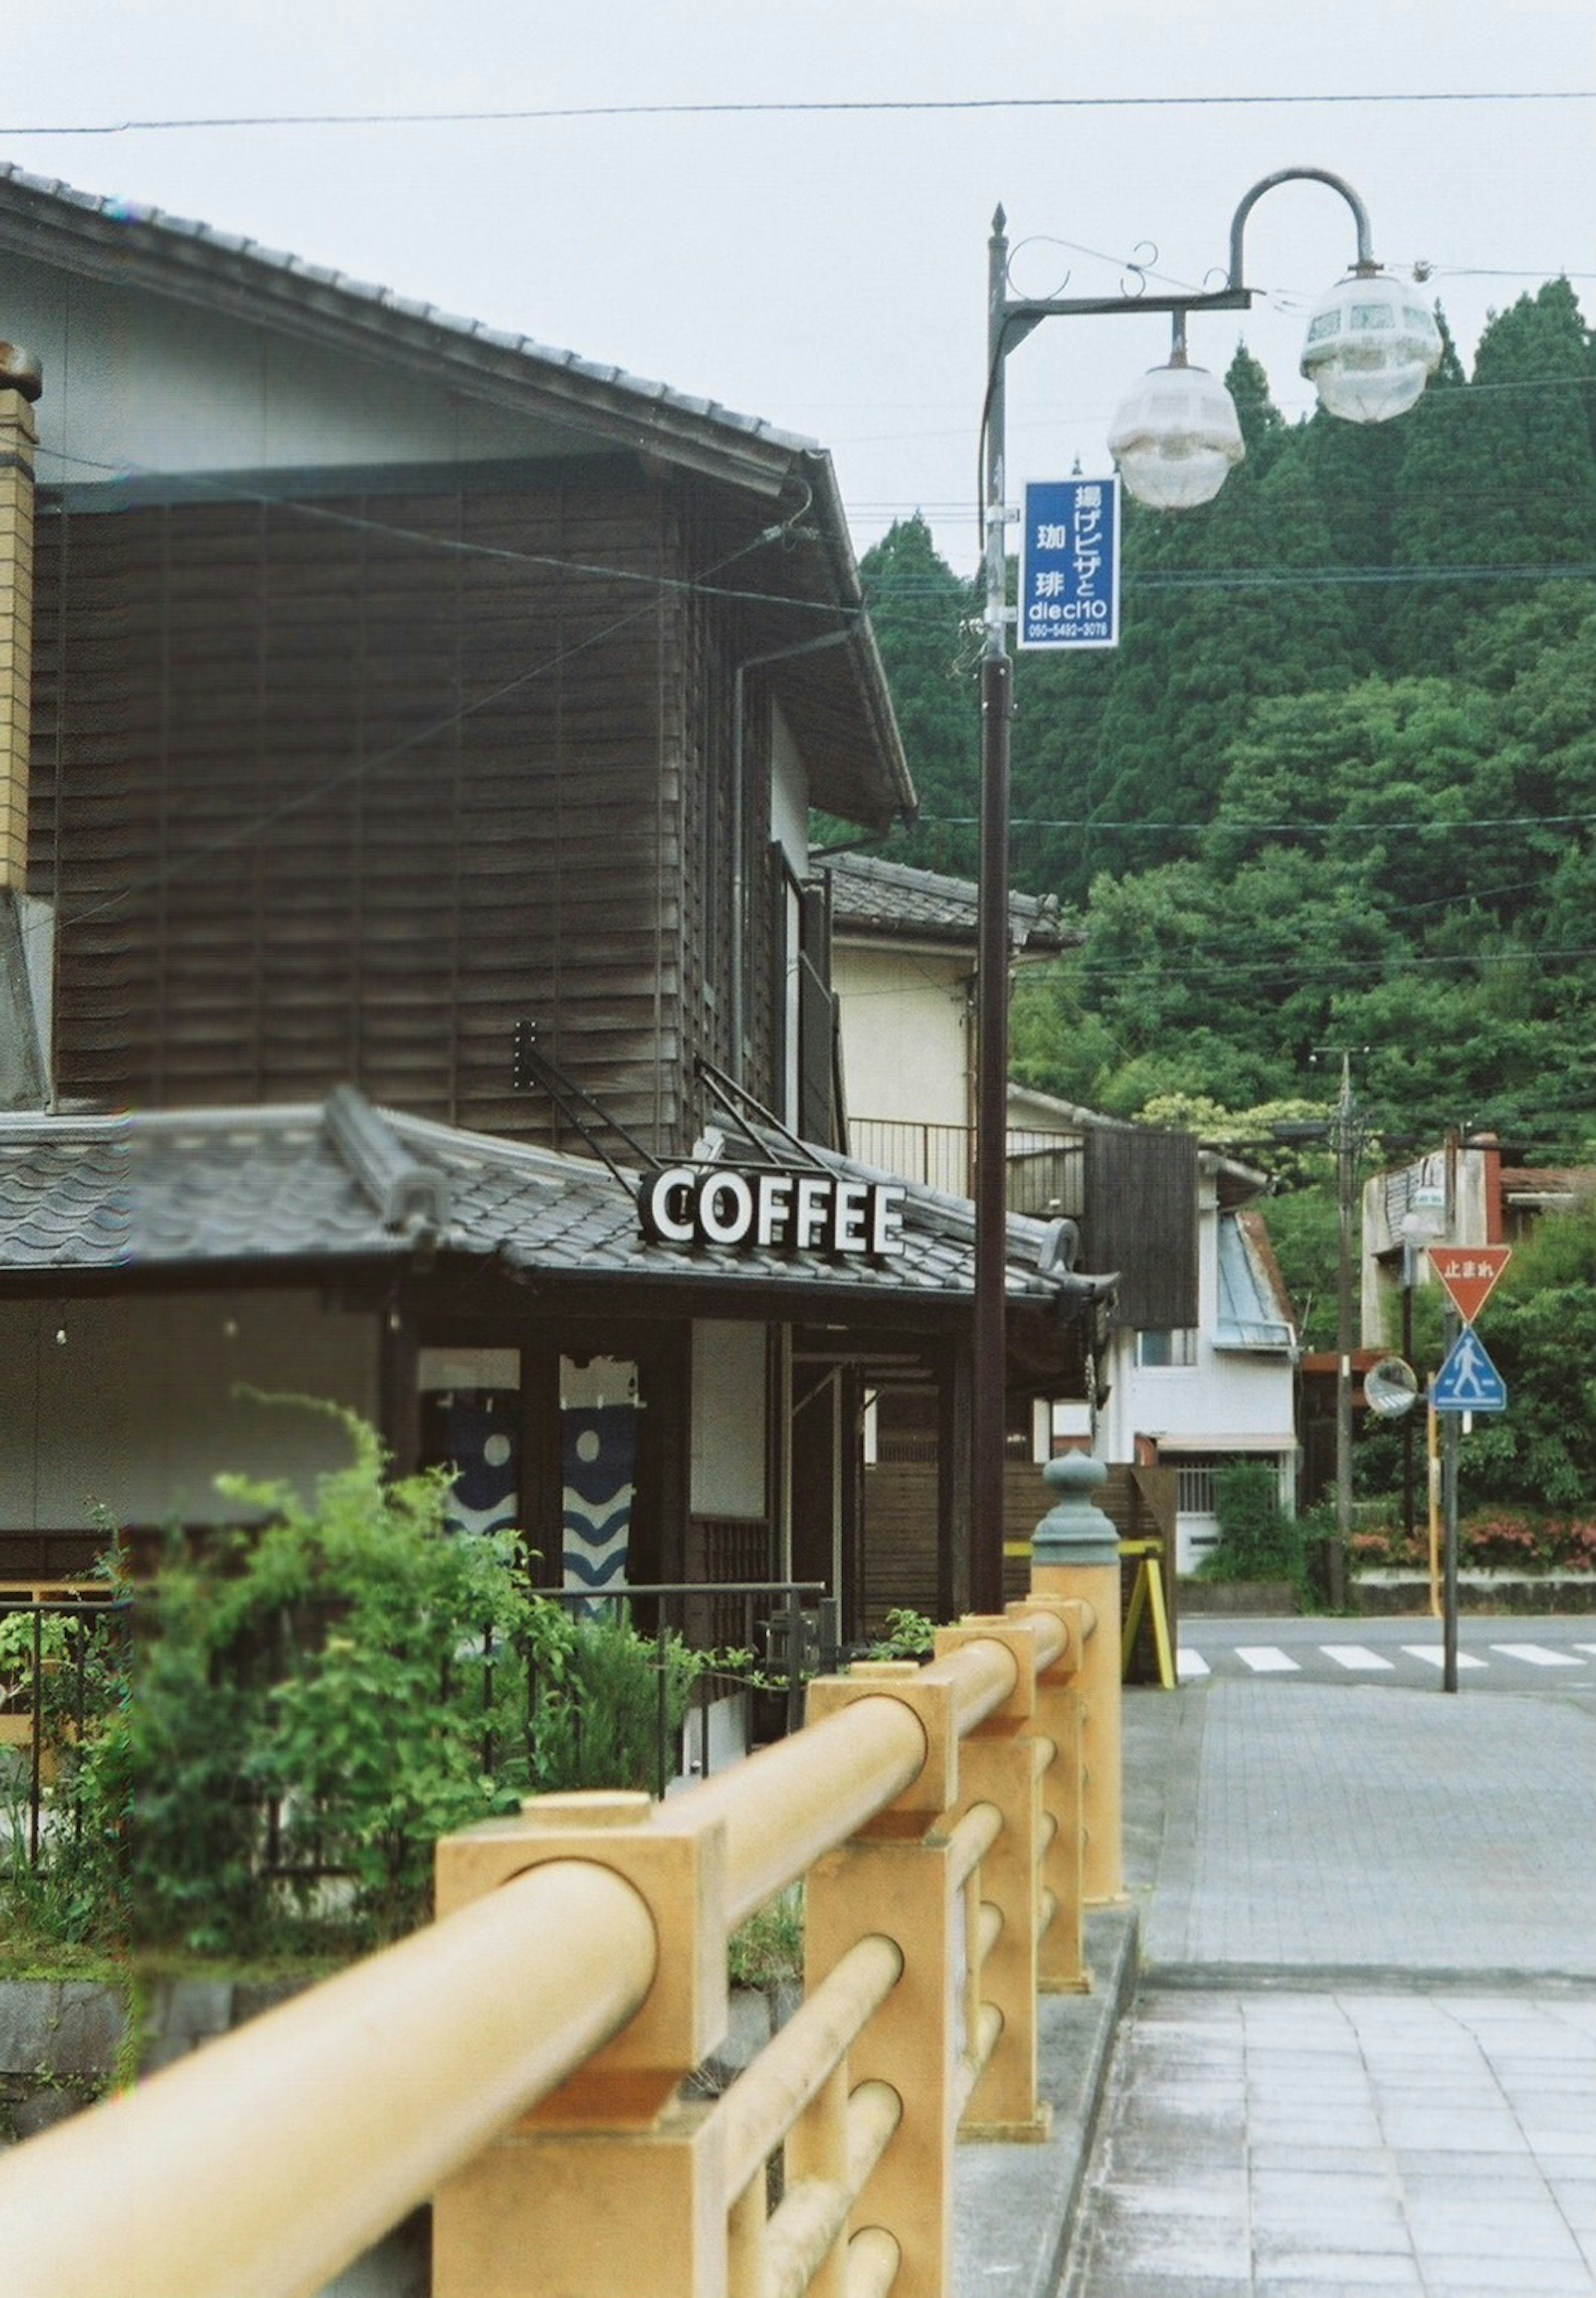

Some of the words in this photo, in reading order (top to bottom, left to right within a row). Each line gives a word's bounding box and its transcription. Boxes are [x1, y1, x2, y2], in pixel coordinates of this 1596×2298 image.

[1036, 524, 1065, 597] 珈琲
[1074, 485, 1102, 597] 揚げピザと
[651, 1168, 906, 1254] COFFEE
[1444, 1260, 1493, 1278] 止まれ
